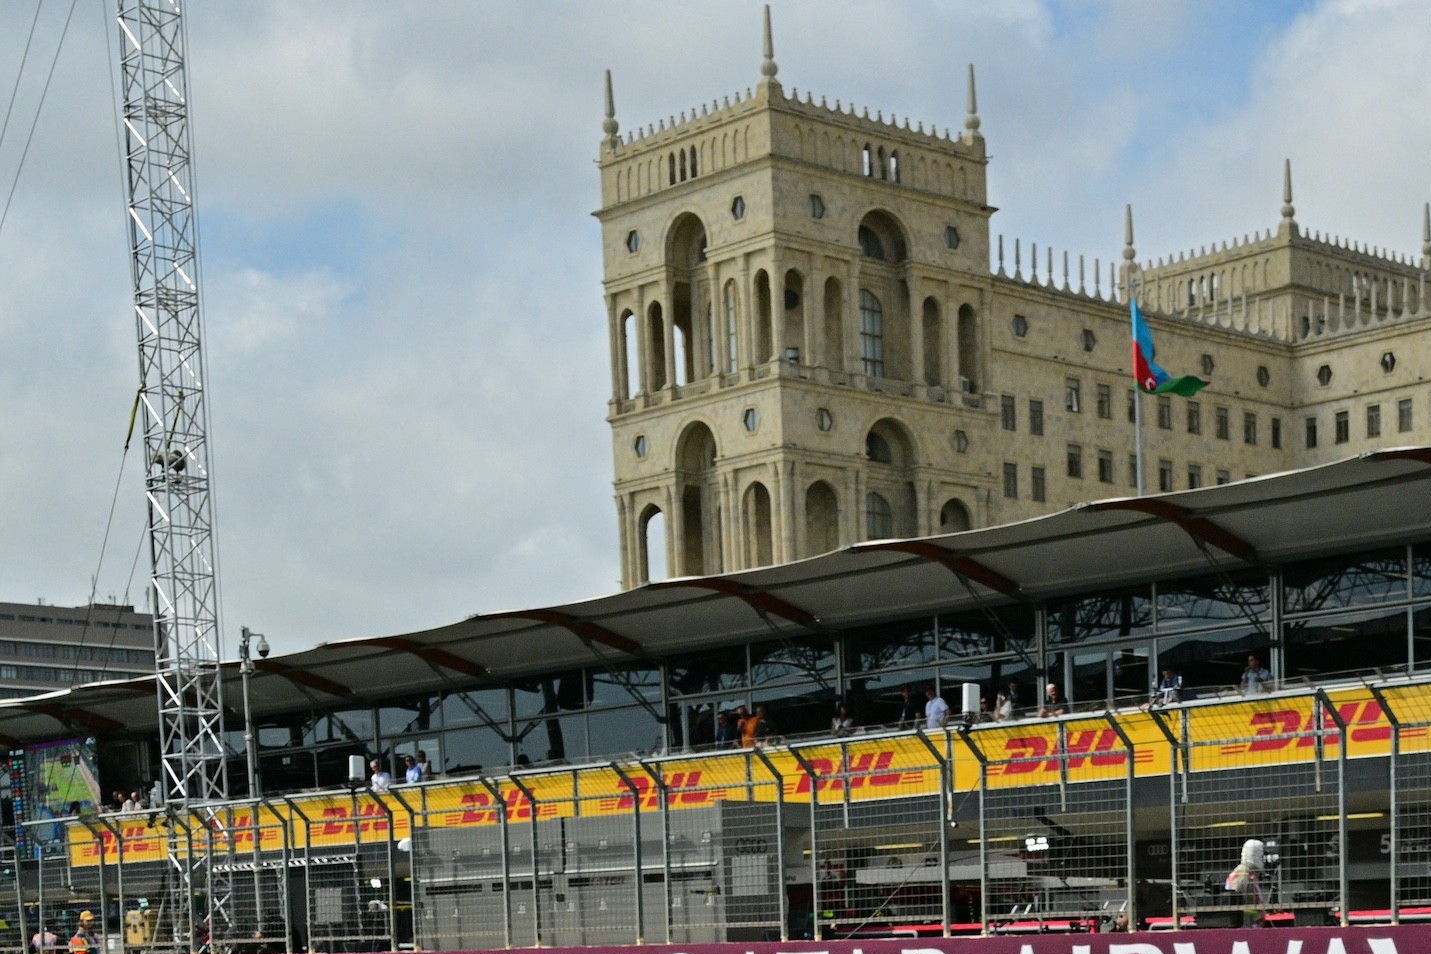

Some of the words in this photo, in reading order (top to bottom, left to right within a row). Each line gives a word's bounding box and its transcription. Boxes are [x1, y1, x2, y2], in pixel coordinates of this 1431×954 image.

[1249, 700, 1394, 752] DHL
[1003, 728, 1129, 776] DHL
[617, 771, 709, 810] DHL
[797, 752, 902, 794] DHL
[322, 804, 391, 836] DHL
[460, 788, 539, 823] DHL
[93, 826, 150, 855] DHL
